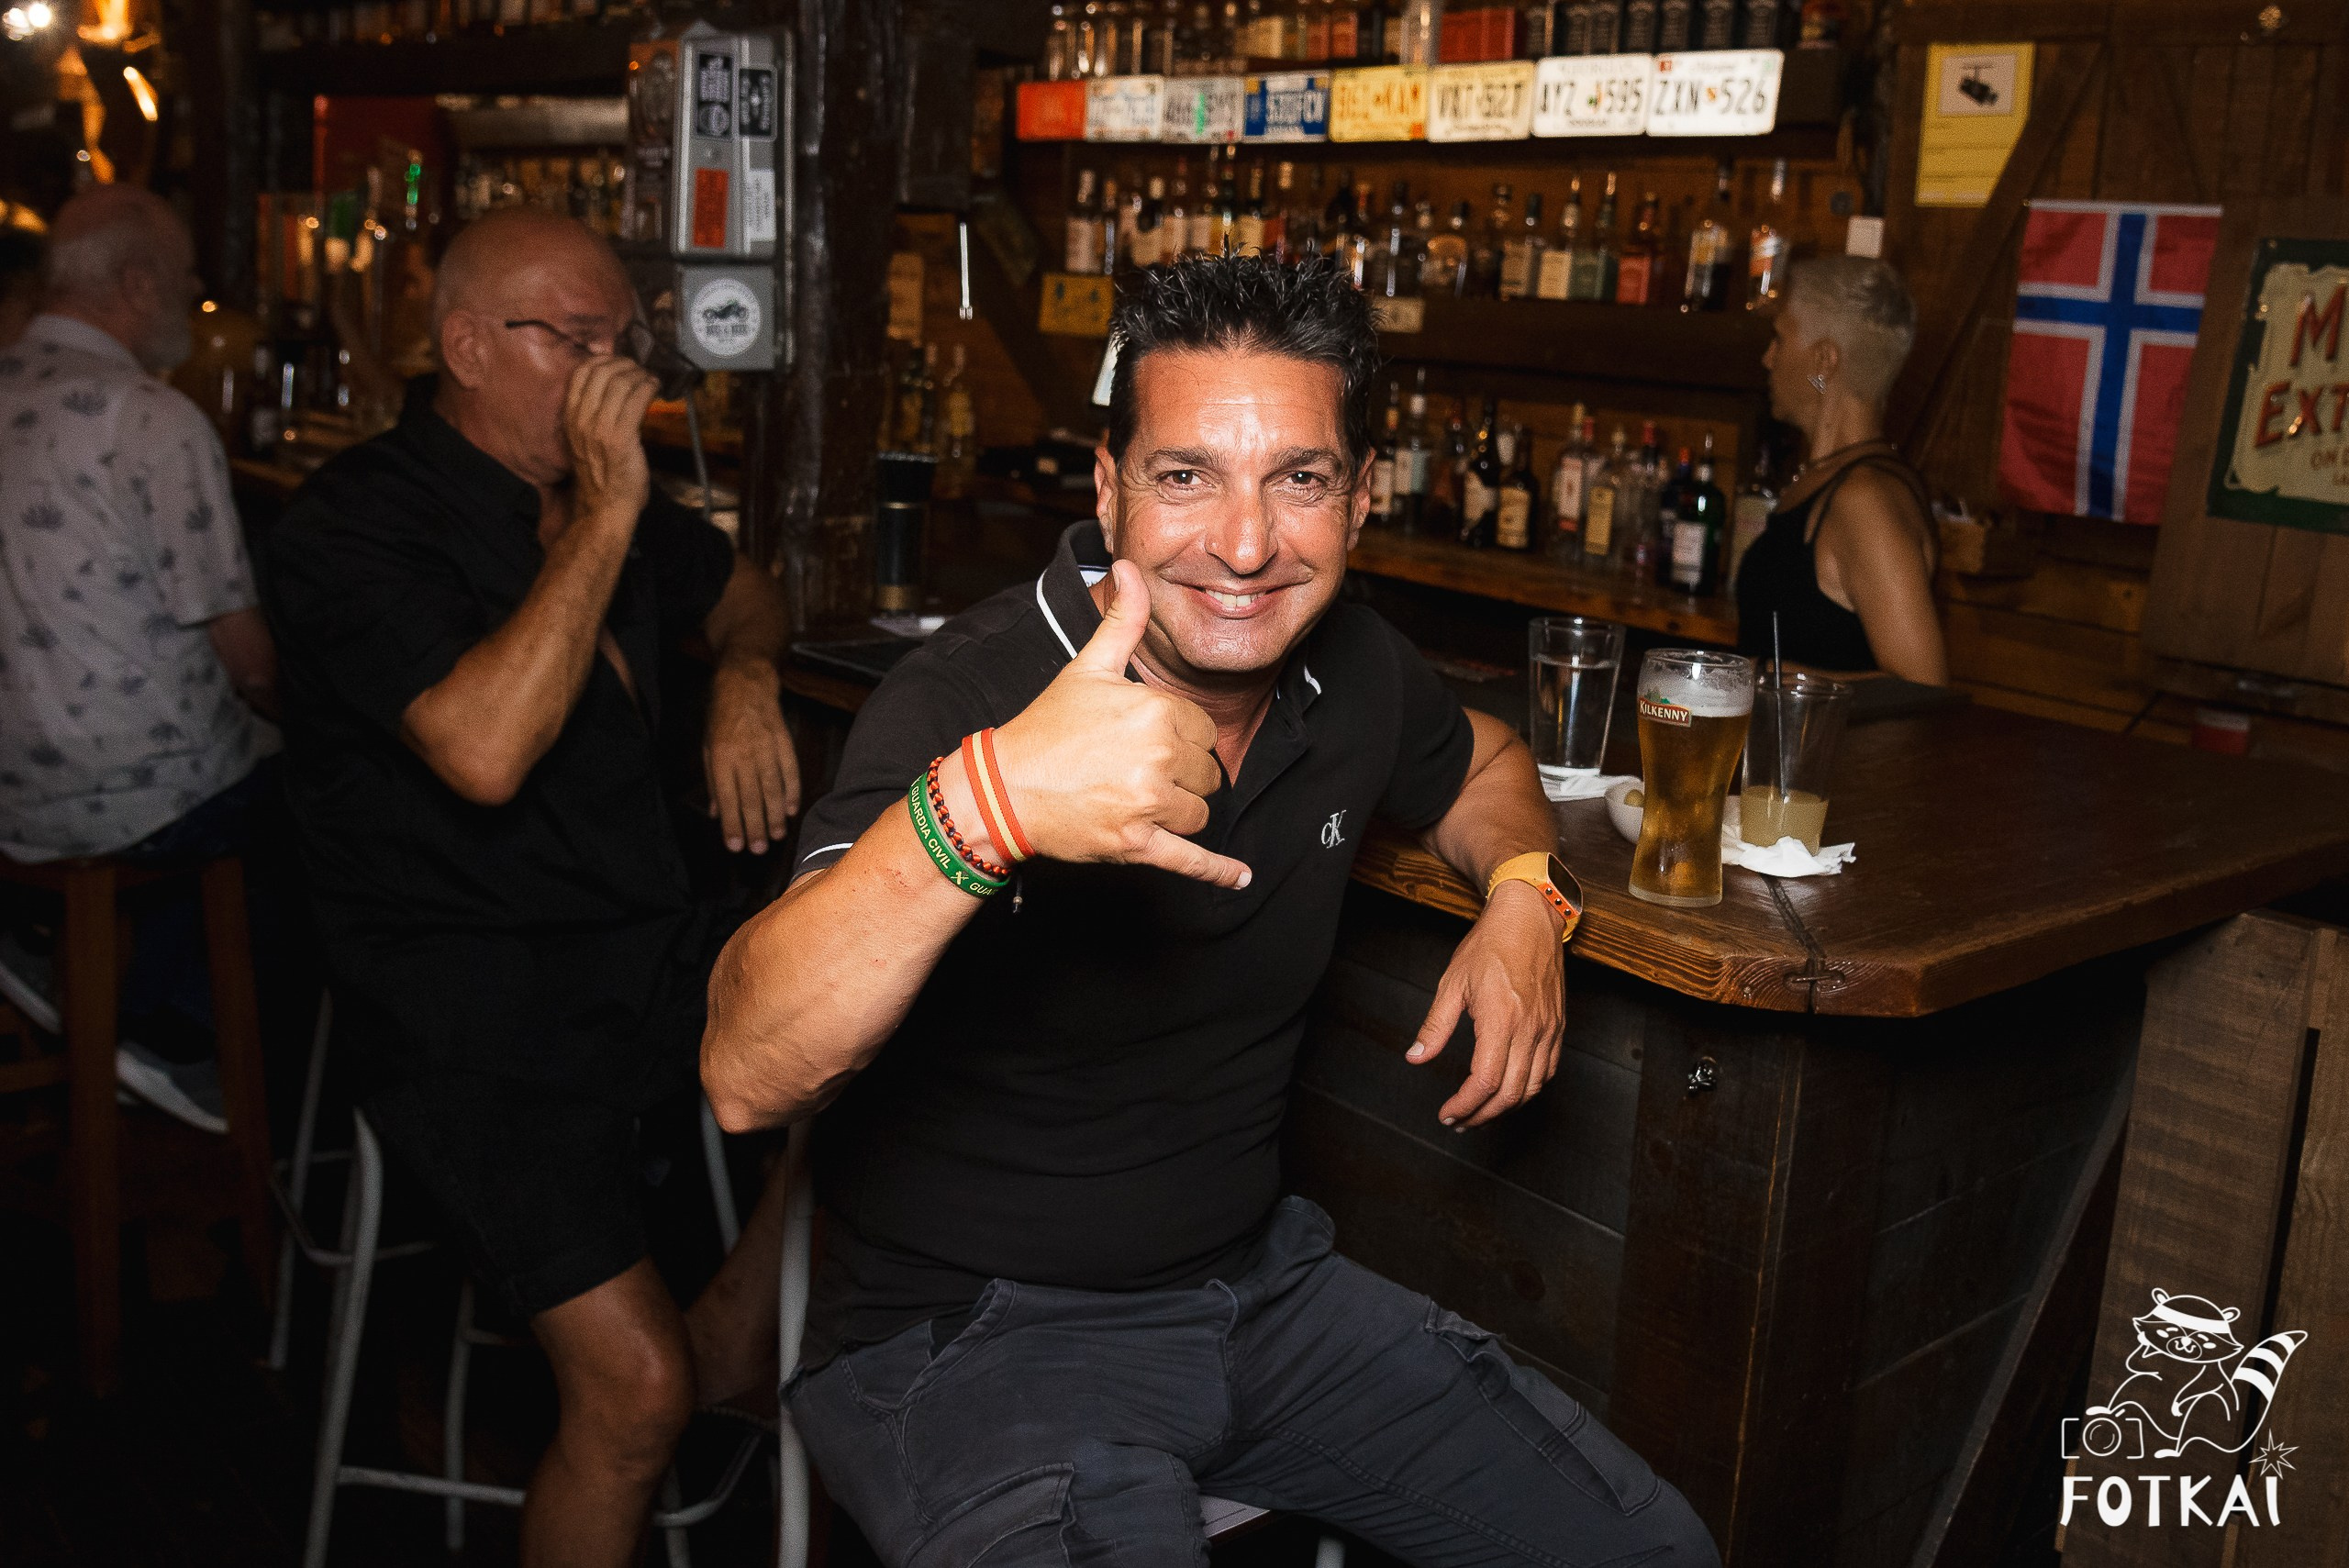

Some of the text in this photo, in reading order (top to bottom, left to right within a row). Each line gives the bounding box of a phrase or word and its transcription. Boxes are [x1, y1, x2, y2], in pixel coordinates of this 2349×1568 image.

[1654, 78, 1766, 116] ZXN 526
[2290, 282, 2348, 367] M
[1640, 700, 1688, 722] KILKENNY
[911, 786, 931, 840] GUARDIA
[928, 838, 952, 869] CIVIL
